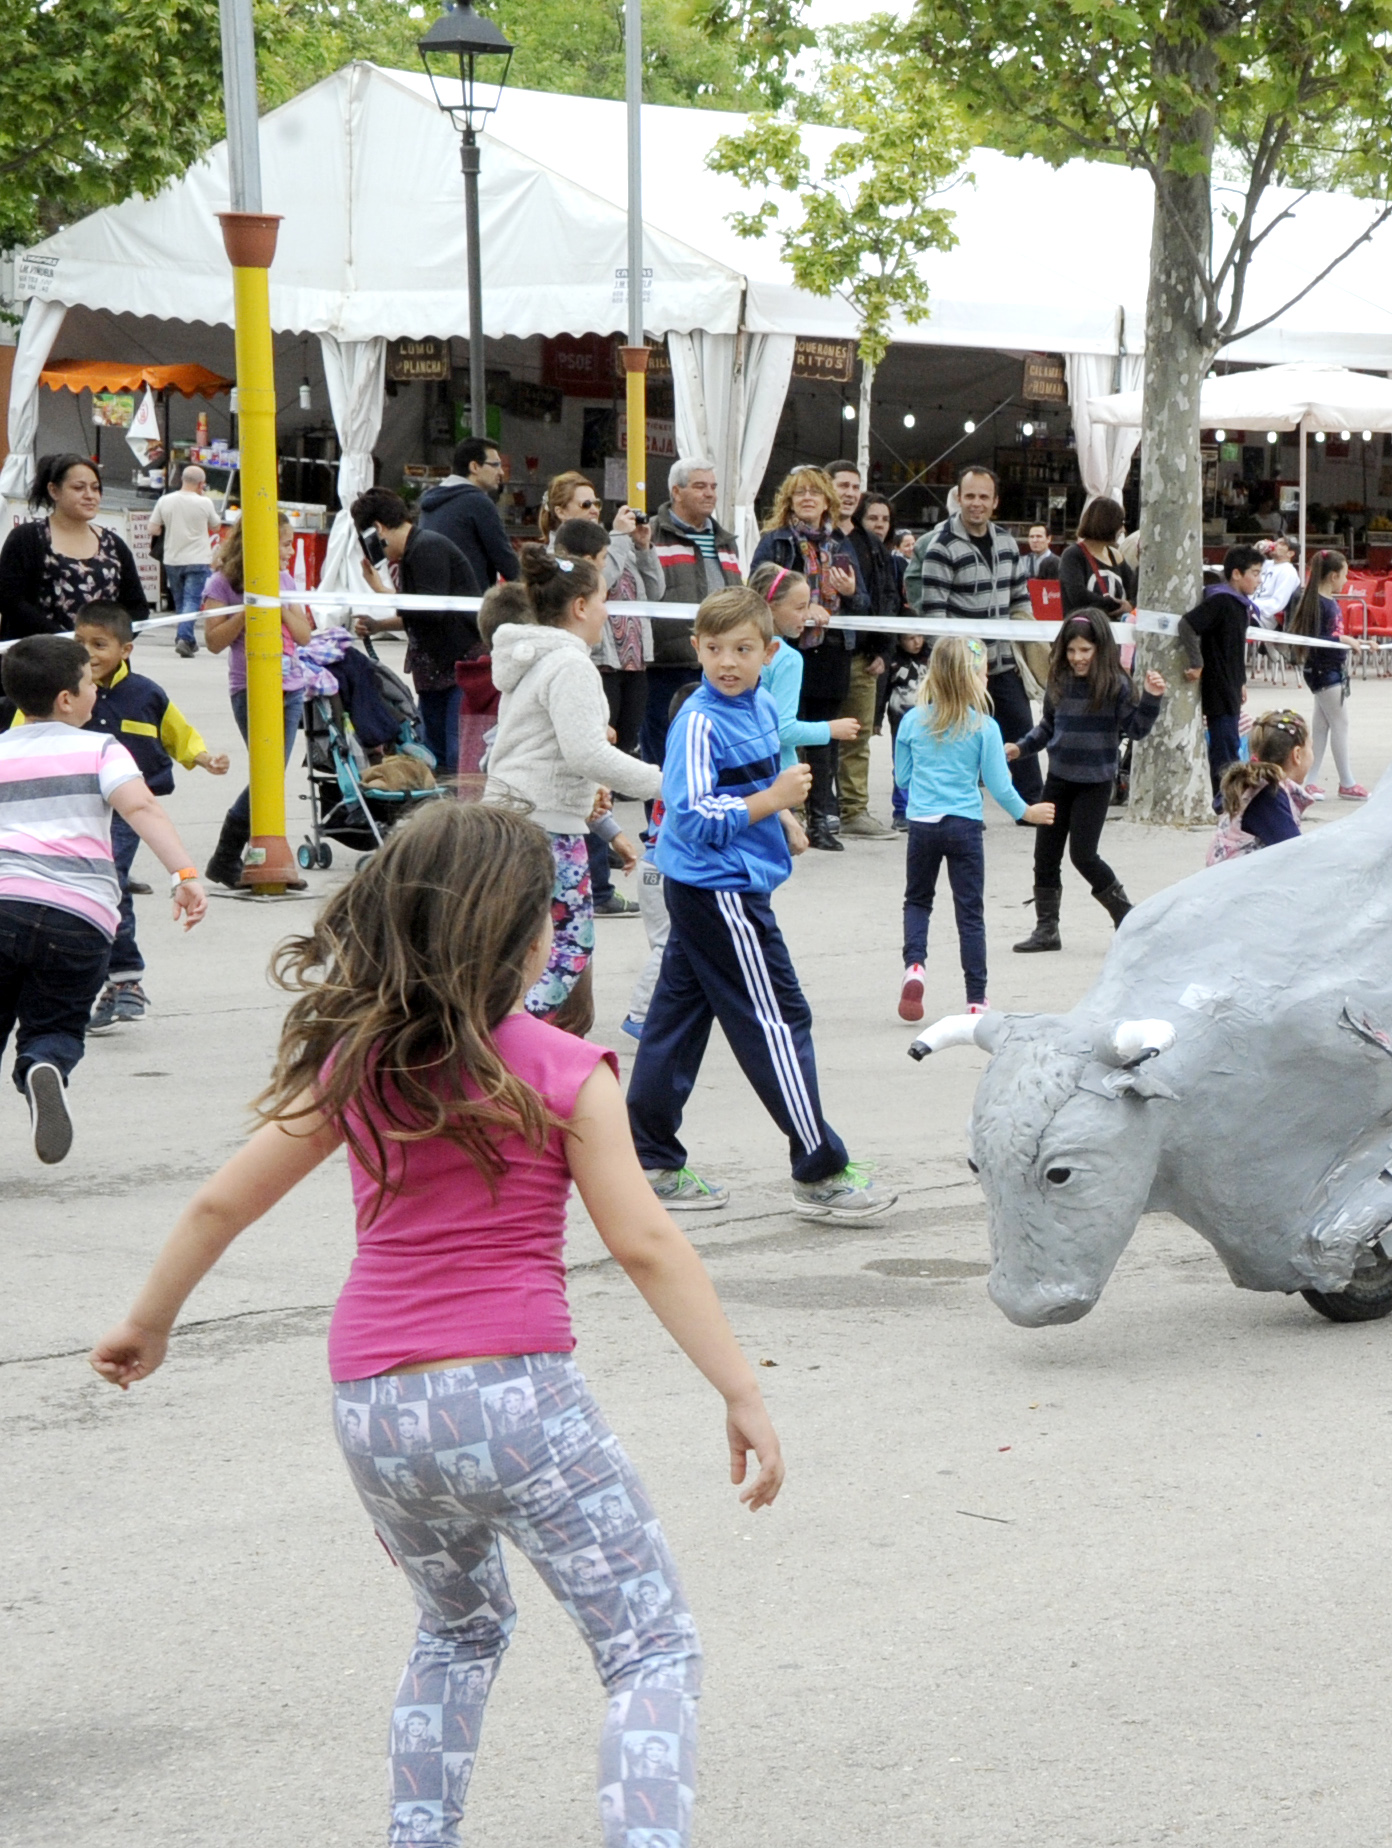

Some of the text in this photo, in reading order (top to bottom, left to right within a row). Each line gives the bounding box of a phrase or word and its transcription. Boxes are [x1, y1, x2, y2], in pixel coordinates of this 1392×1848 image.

[615, 268, 653, 278] CAAS
[648, 357, 670, 369] RILL
[796, 354, 843, 369] RITOS
[644, 873, 658, 885] 78
